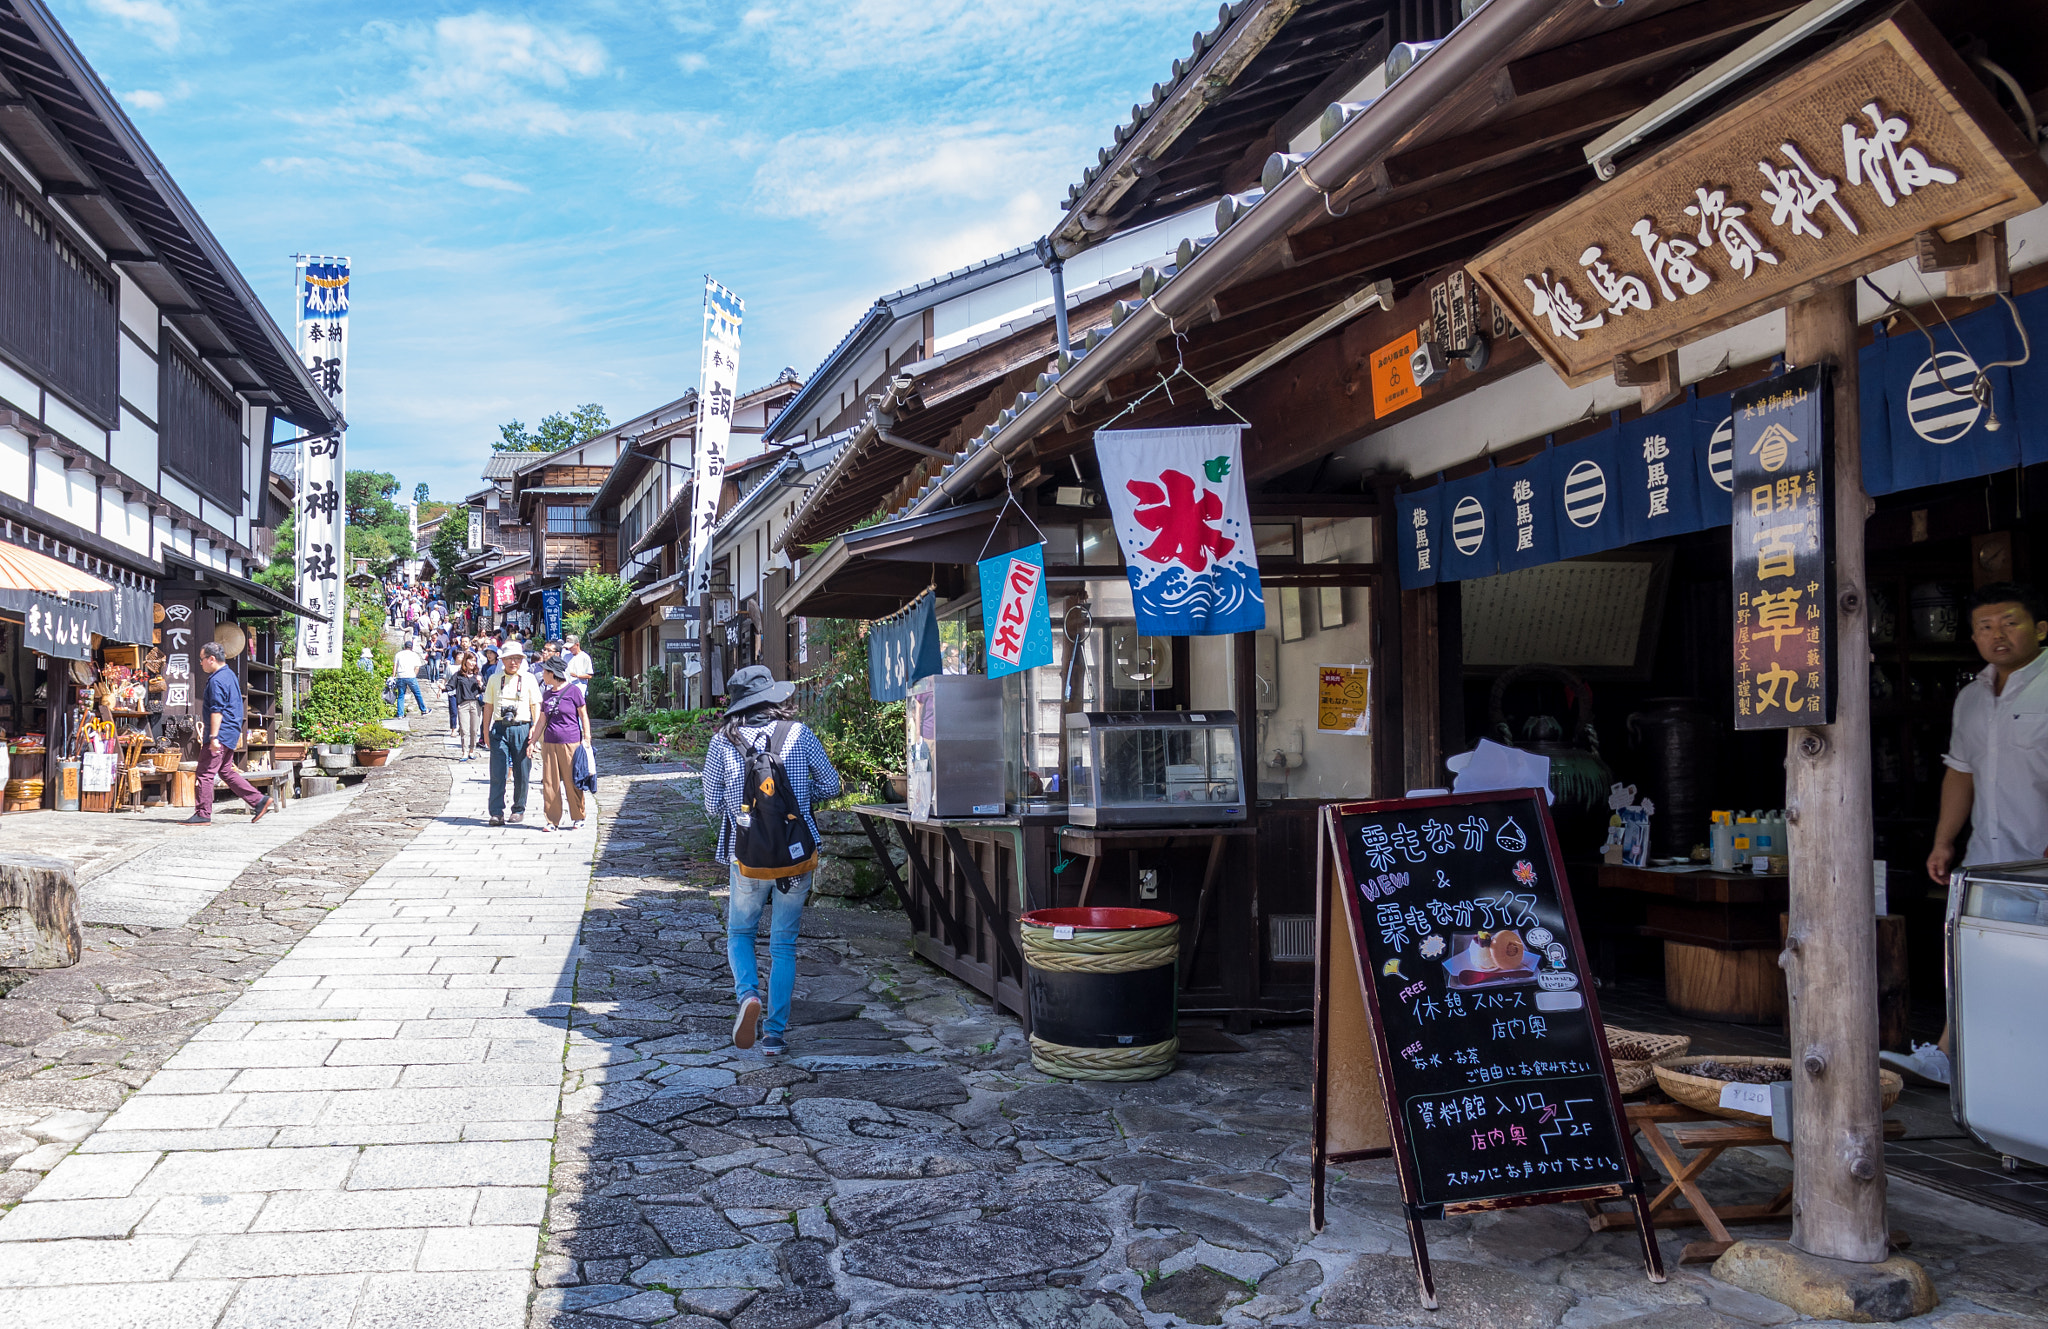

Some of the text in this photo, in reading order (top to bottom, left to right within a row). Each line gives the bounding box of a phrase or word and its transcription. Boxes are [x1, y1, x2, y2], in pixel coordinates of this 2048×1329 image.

[308, 322, 343, 343] 奉納
[1743, 388, 1808, 421] 木曽御嶽山
[1643, 434, 1670, 519] 槌馬屋
[1513, 478, 1534, 552] 槌馬屋
[1752, 475, 1802, 518] 日野
[1125, 468, 1236, 572] 氷
[1412, 507, 1431, 572] 槌馬屋
[307, 597, 321, 656] 馬町三組
[1751, 522, 1805, 715] 百草丸
[1737, 591, 1751, 716] 日野屋文平謹製
[1361, 815, 1489, 873] 栗もなか
[1360, 871, 1410, 902] NEW
[1436, 869, 1451, 889] &
[1376, 890, 1540, 953] 栗もなかアイス
[1399, 980, 1427, 1004] FREE
[1492, 1014, 1548, 1041] 店内奥
[1400, 1040, 1424, 1060] FREE
[1465, 1060, 1590, 1083] ご自由にお飲み下さい
[1471, 1124, 1528, 1151] 店内奥
[1569, 1123, 1593, 1137] 2F
